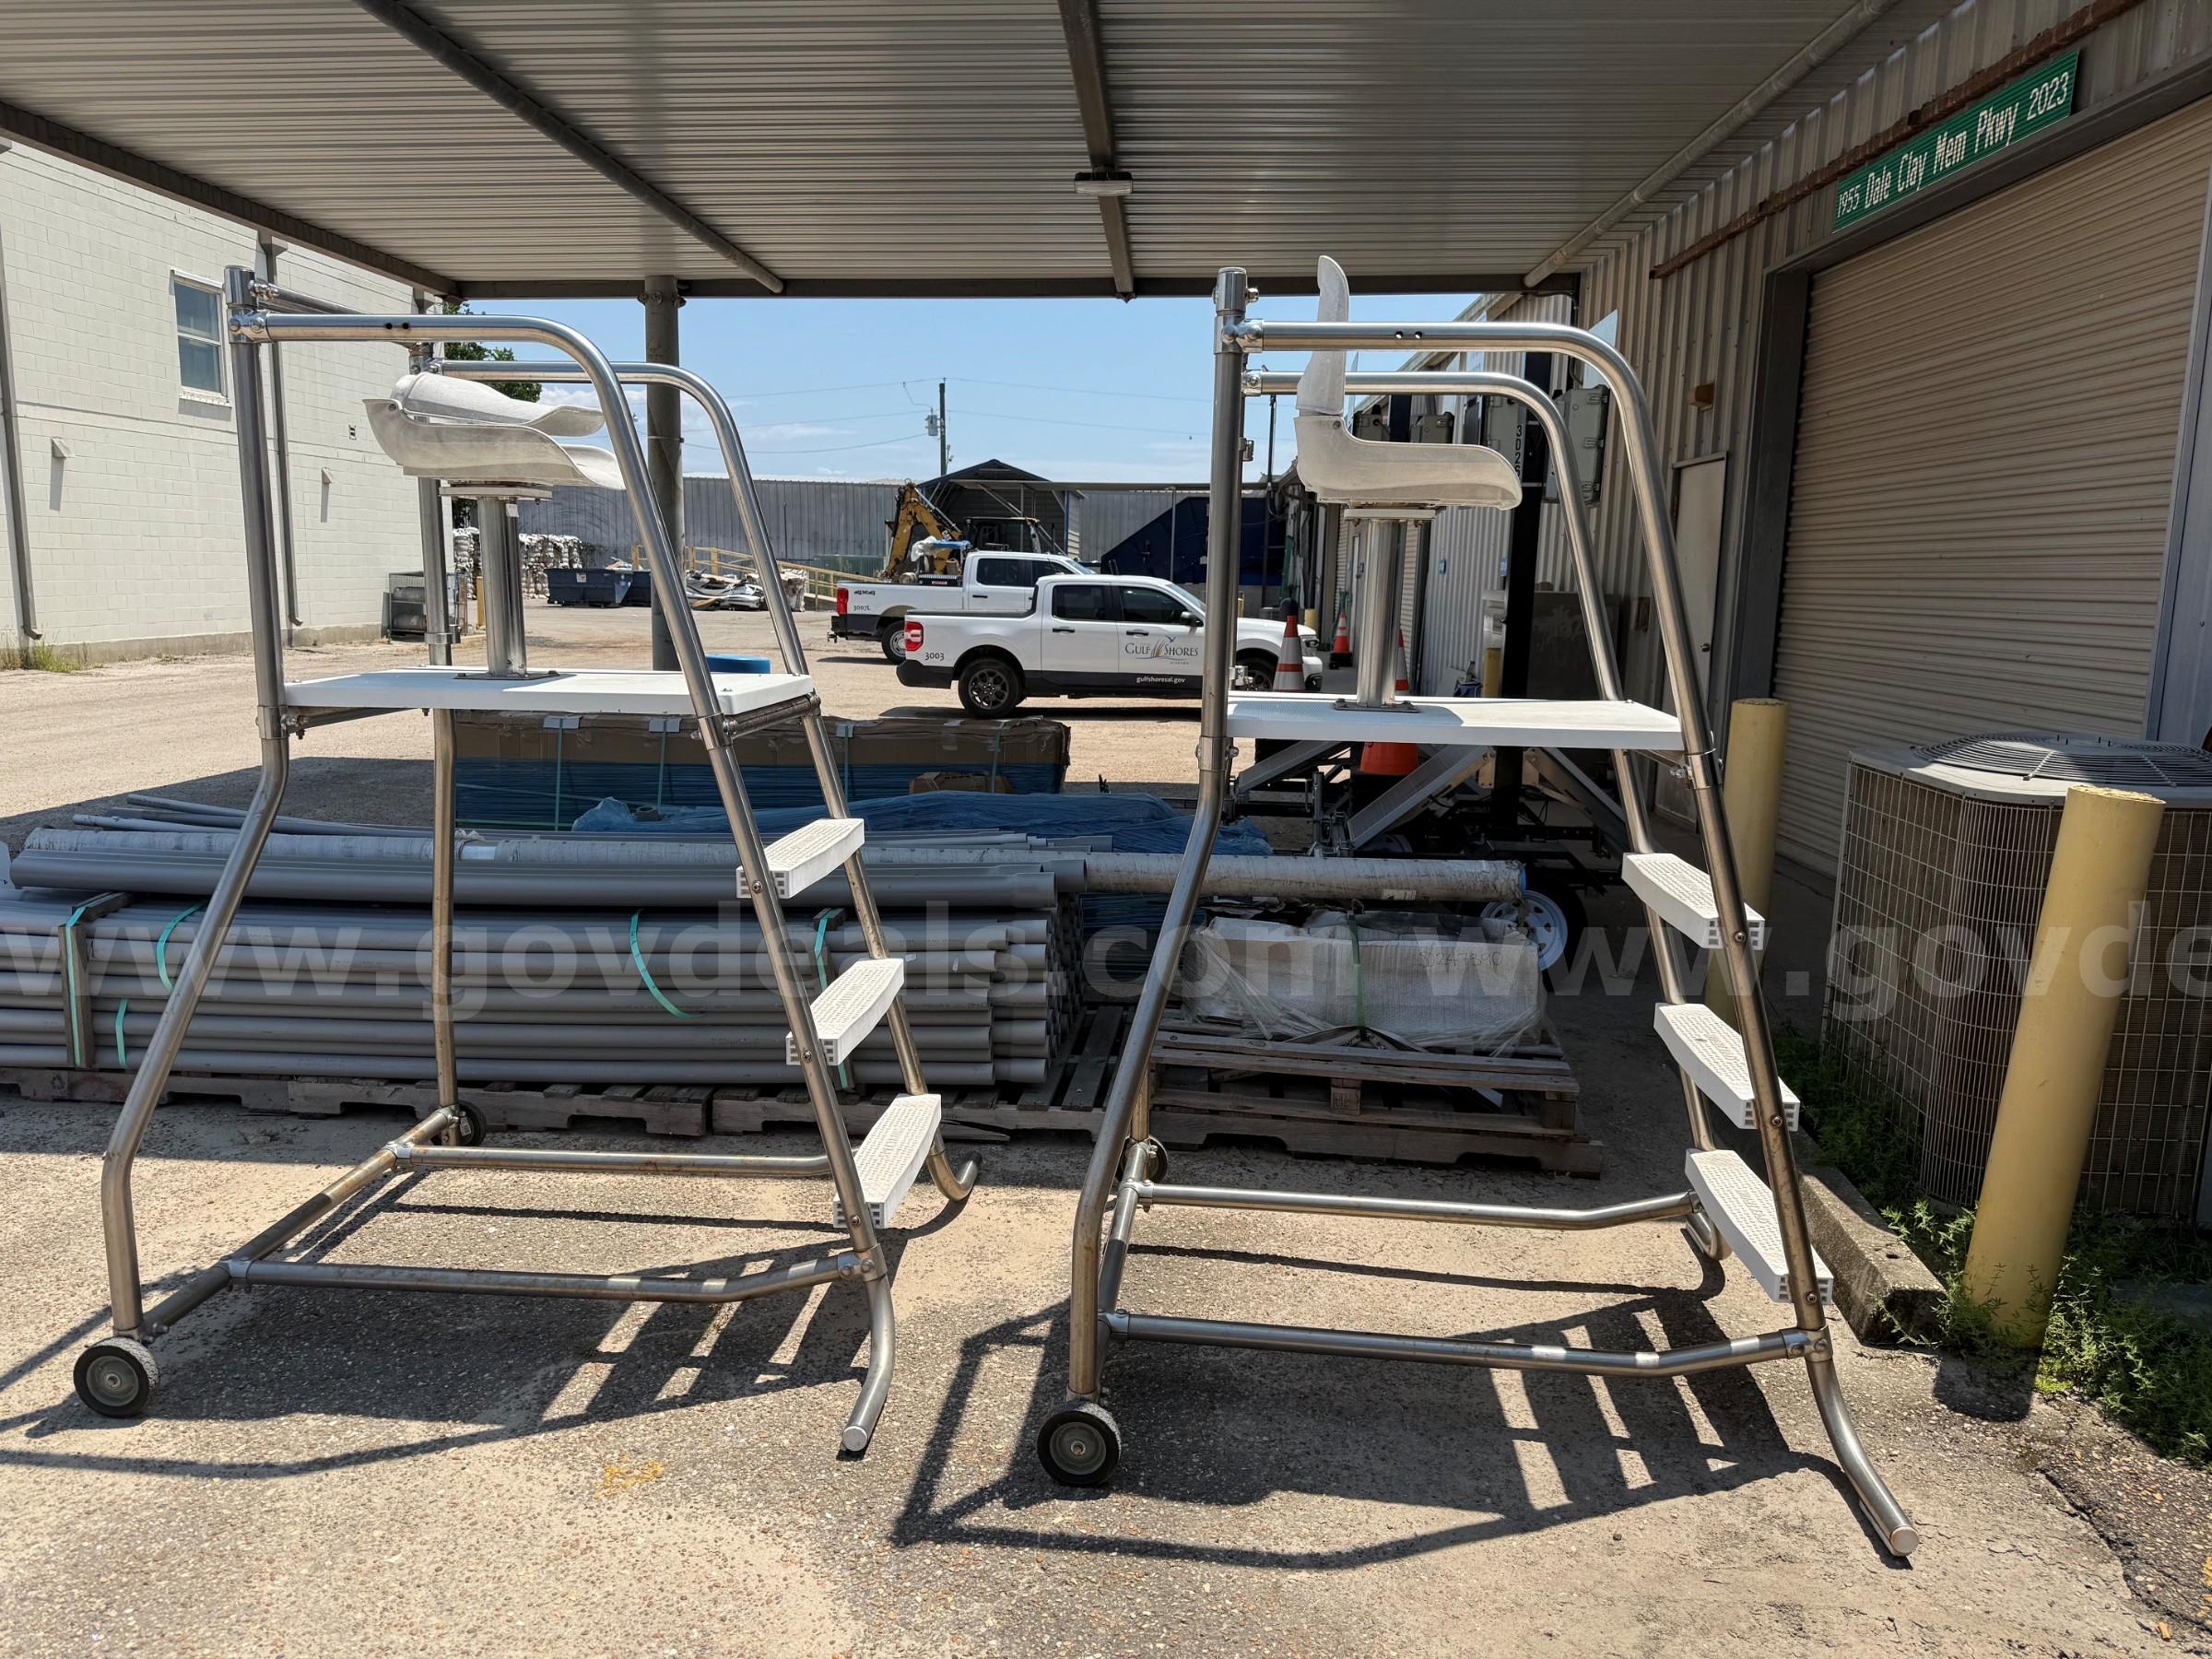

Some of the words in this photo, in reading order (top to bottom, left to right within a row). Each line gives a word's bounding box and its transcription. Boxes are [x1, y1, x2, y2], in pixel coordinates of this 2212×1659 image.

[1837, 183, 1860, 218] 1955
[1865, 166, 1890, 209] Dale
[1898, 150, 1928, 192] Clay
[1933, 130, 1967, 175] Mem
[1974, 101, 2019, 153] Pkwy
[2026, 71, 2070, 122] 2023
[924, 653, 945, 661] 3003
